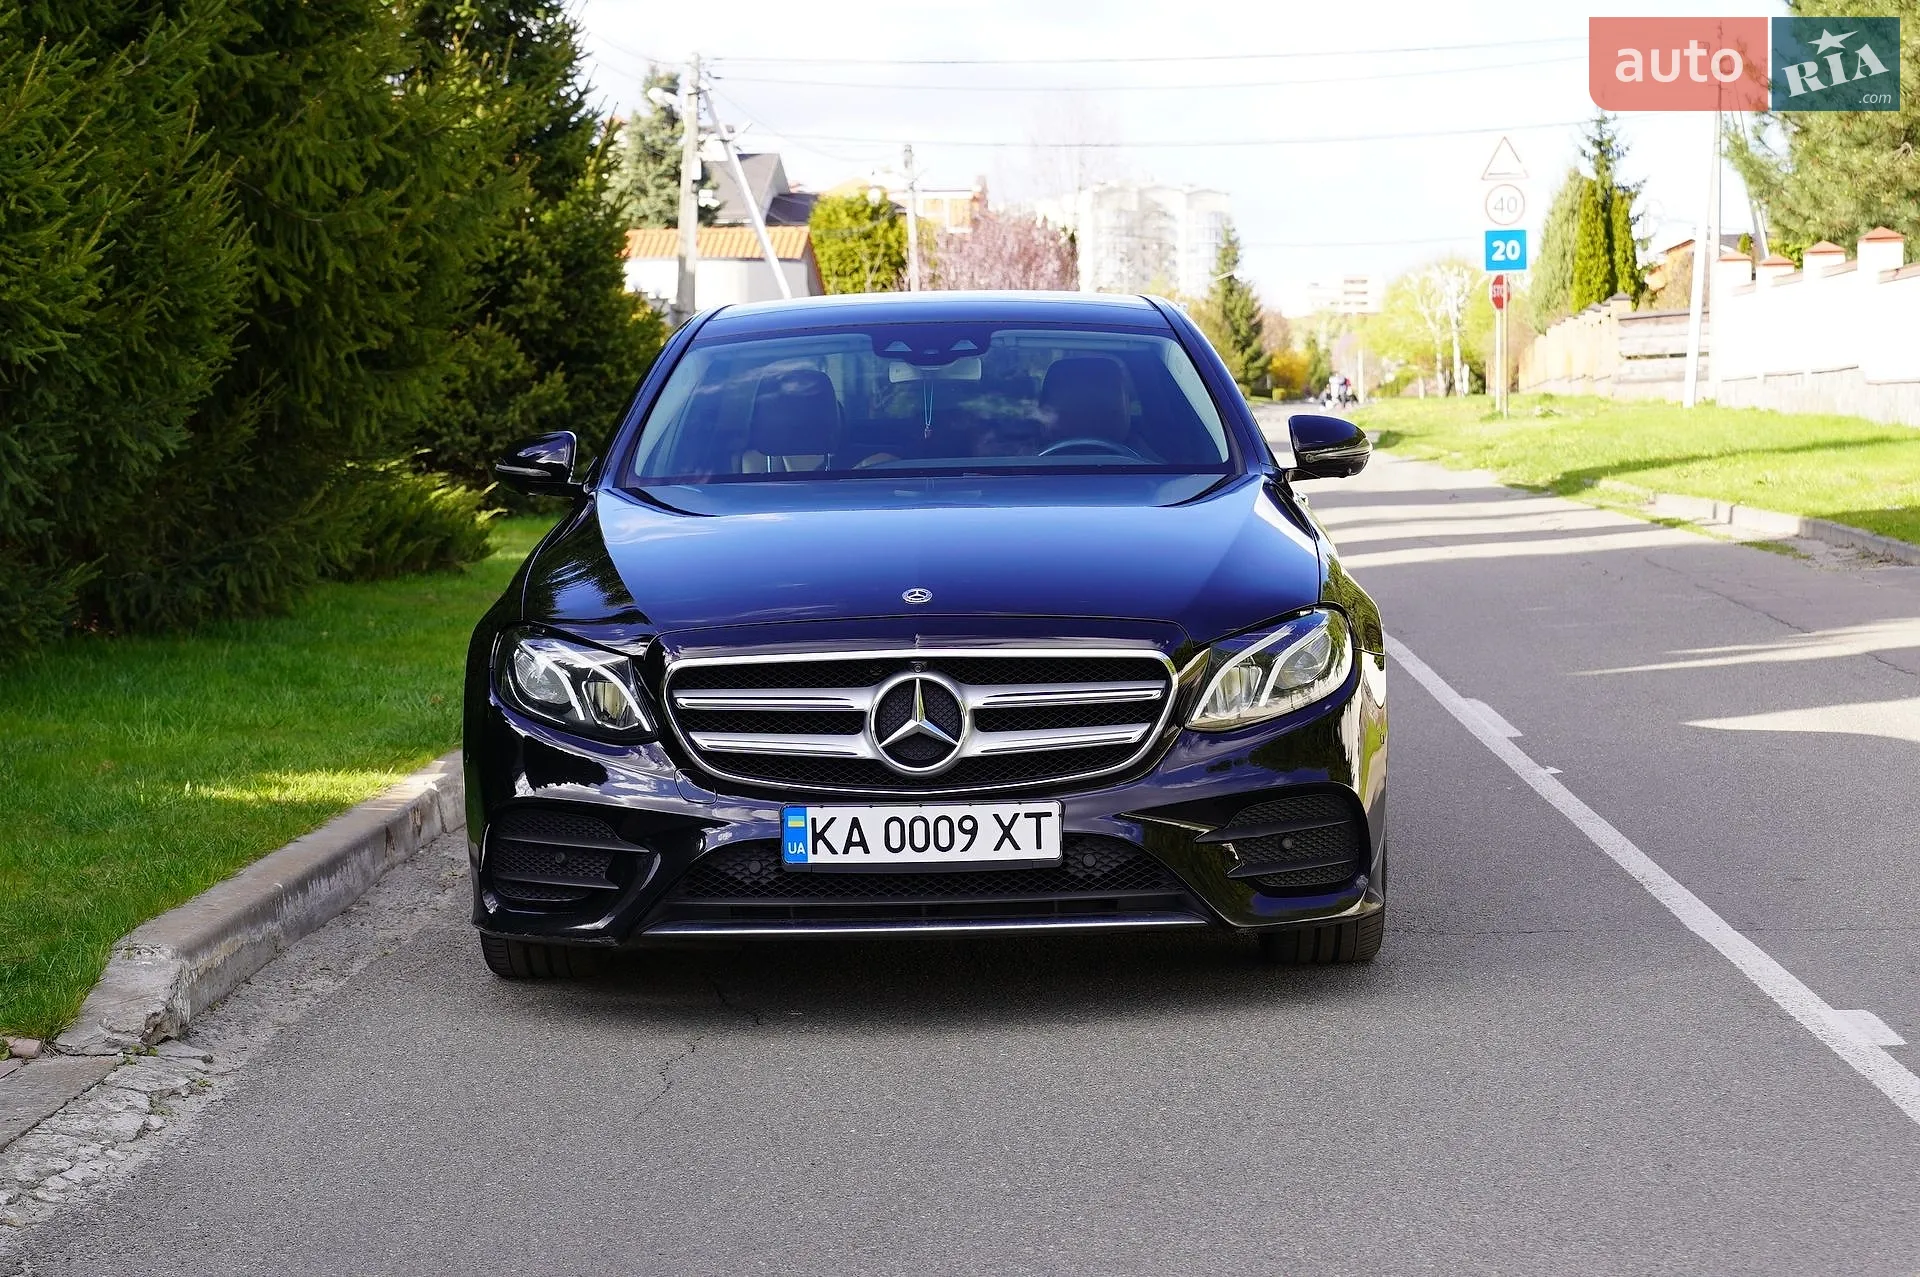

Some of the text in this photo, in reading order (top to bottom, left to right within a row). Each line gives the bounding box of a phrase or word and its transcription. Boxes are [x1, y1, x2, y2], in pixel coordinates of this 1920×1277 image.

[1492, 196, 1518, 216] 40
[1491, 239, 1521, 262] 20
[811, 811, 1053, 855] KA 0009 XT
[788, 841, 806, 855] UA
